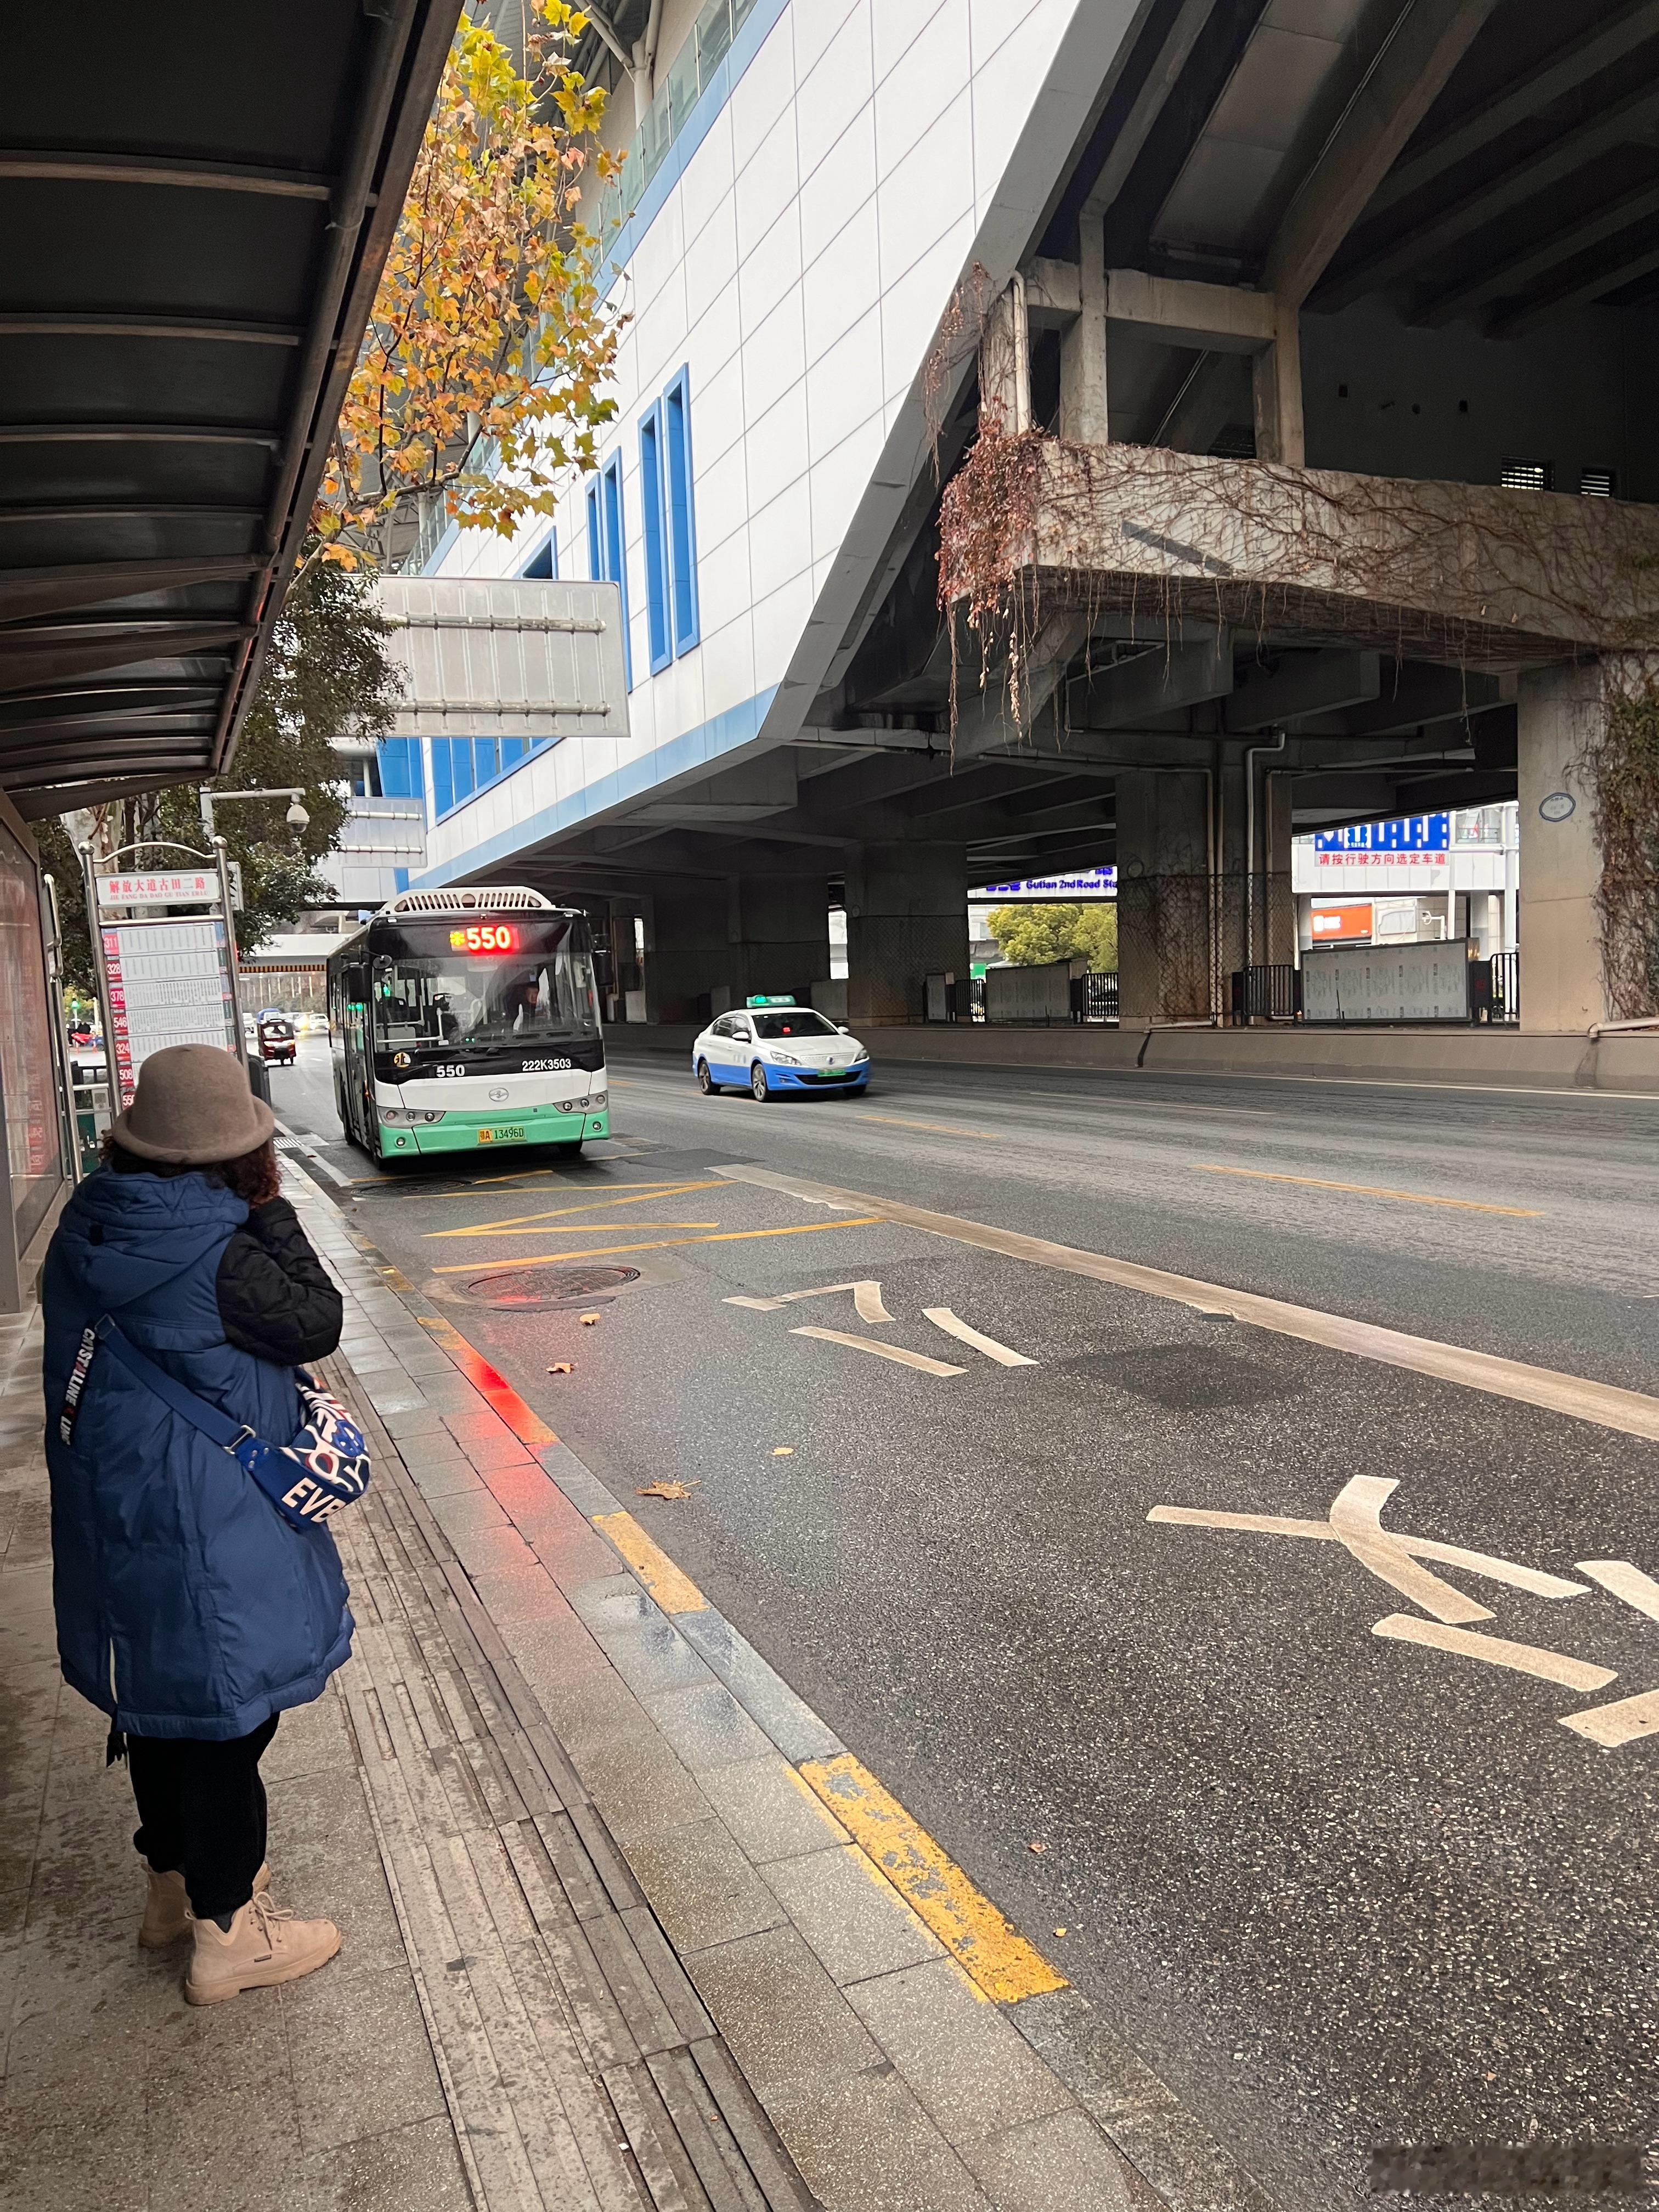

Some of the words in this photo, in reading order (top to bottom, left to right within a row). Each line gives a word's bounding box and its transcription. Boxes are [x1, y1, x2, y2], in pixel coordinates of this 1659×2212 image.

[1319, 853, 1446, 865] 请按行驶方向选定车道
[110, 877, 205, 893] 解放大道古田二路
[1026, 879, 1057, 889] Gutian
[1059, 880, 1075, 888] 2nd
[1077, 879, 1100, 888] Road
[104, 936, 117, 948] 311
[467, 926, 510, 950] 550
[107, 963, 121, 975] 328
[110, 990, 124, 1002] 378
[114, 1017, 127, 1028] 546
[116, 1043, 129, 1054] 324
[436, 1064, 465, 1077] 550
[522, 1058, 572, 1071] 222K3503
[119, 1069, 133, 1080] 508
